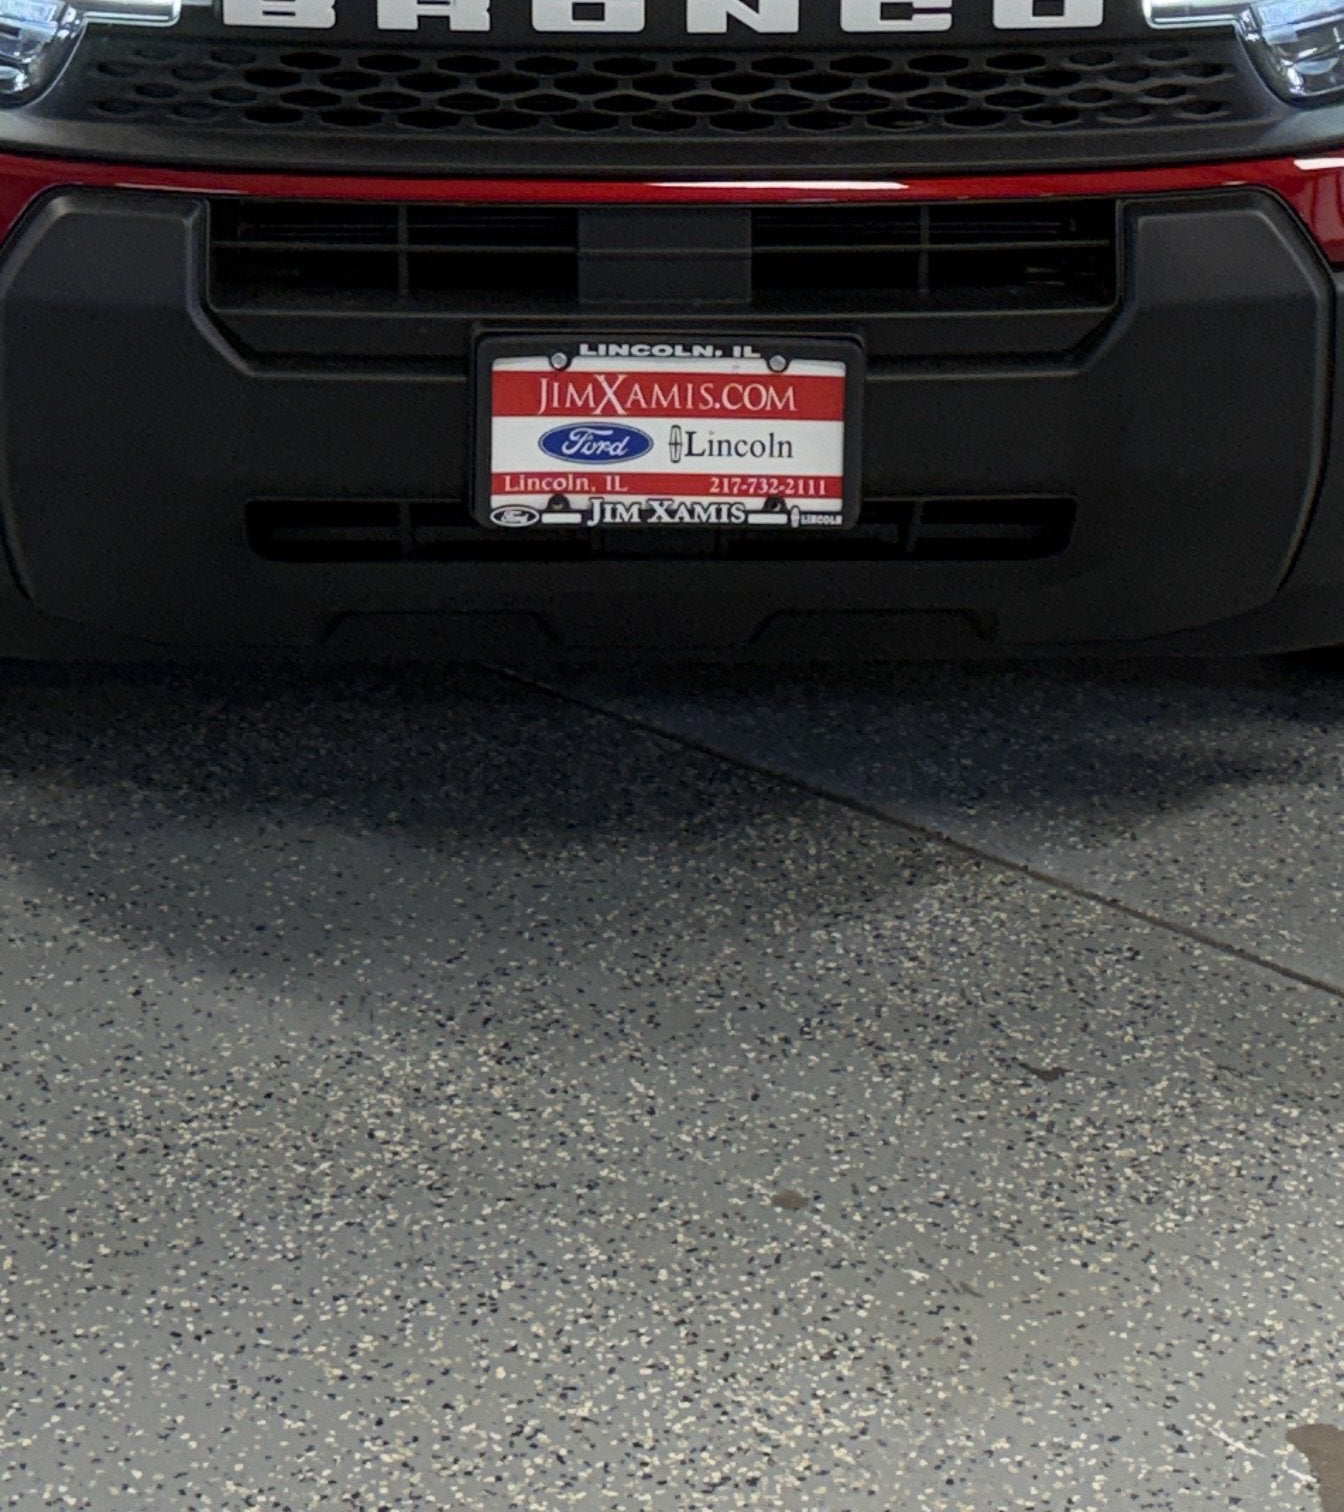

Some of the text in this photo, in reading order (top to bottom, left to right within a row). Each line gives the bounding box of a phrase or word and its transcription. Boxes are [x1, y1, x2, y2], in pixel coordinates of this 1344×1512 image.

[579, 343, 760, 357] LINCOLN, IL
[562, 427, 629, 457] Ford
[685, 431, 793, 458] Lincoln
[505, 474, 627, 491] Lincoln, IL
[710, 477, 825, 495] 217-732-2111
[587, 498, 745, 526] JIM XAMIS
